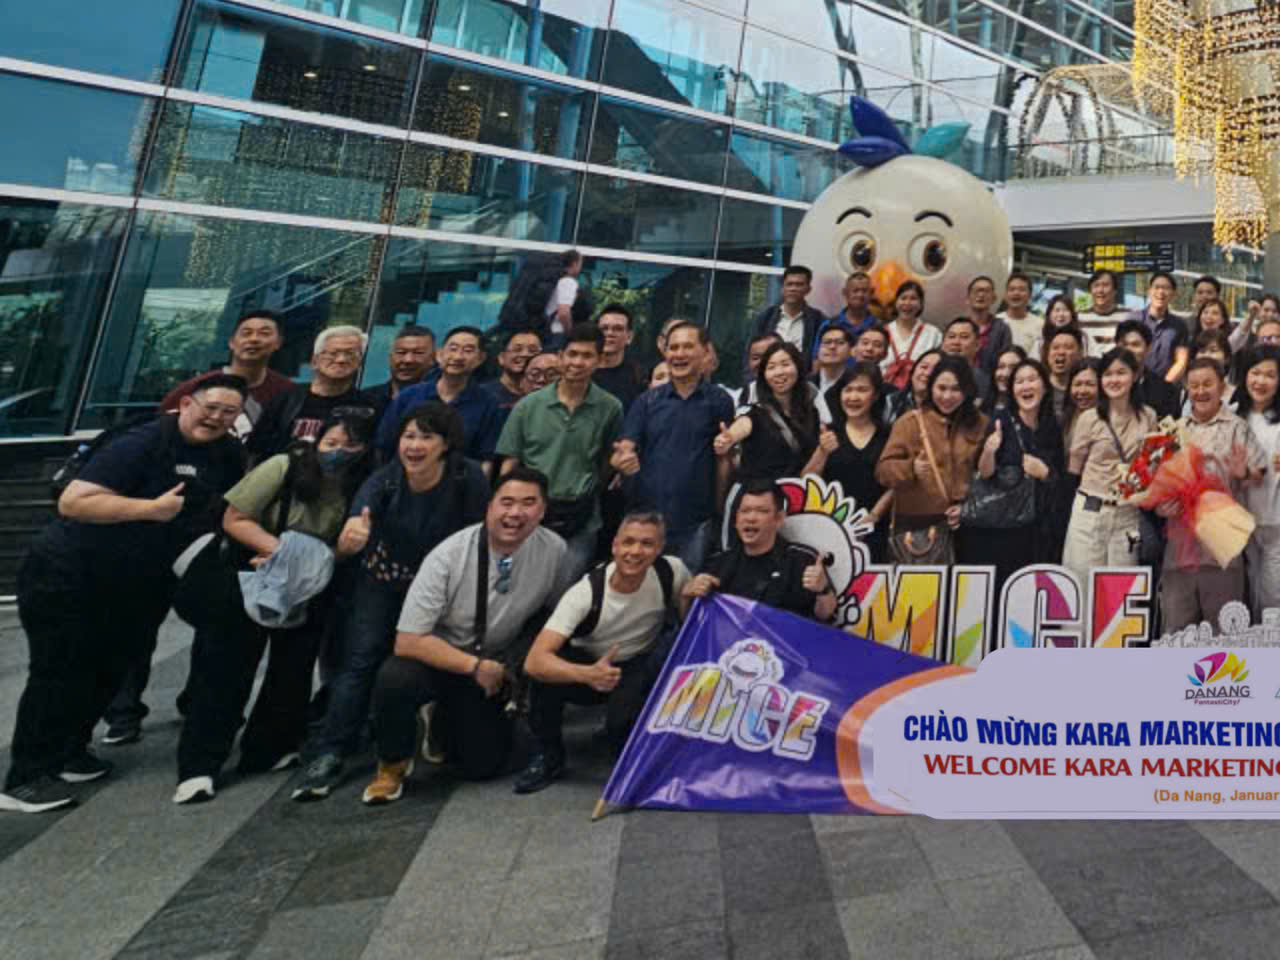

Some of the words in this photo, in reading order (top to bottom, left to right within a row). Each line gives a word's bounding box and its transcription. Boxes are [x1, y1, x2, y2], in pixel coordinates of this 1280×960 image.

[838, 564, 1152, 666] MICE
[1185, 685, 1250, 700] DANANG
[650, 668, 829, 759] MICE
[904, 710, 968, 742] CHÀO
[976, 716, 1057, 746] MỪNG
[1066, 722, 1131, 746] KARA
[924, 754, 1056, 776] WELCOME
[1065, 758, 1132, 776] KARA
[1154, 790, 1179, 803] (Da
[1184, 790, 1225, 804] Nang,
